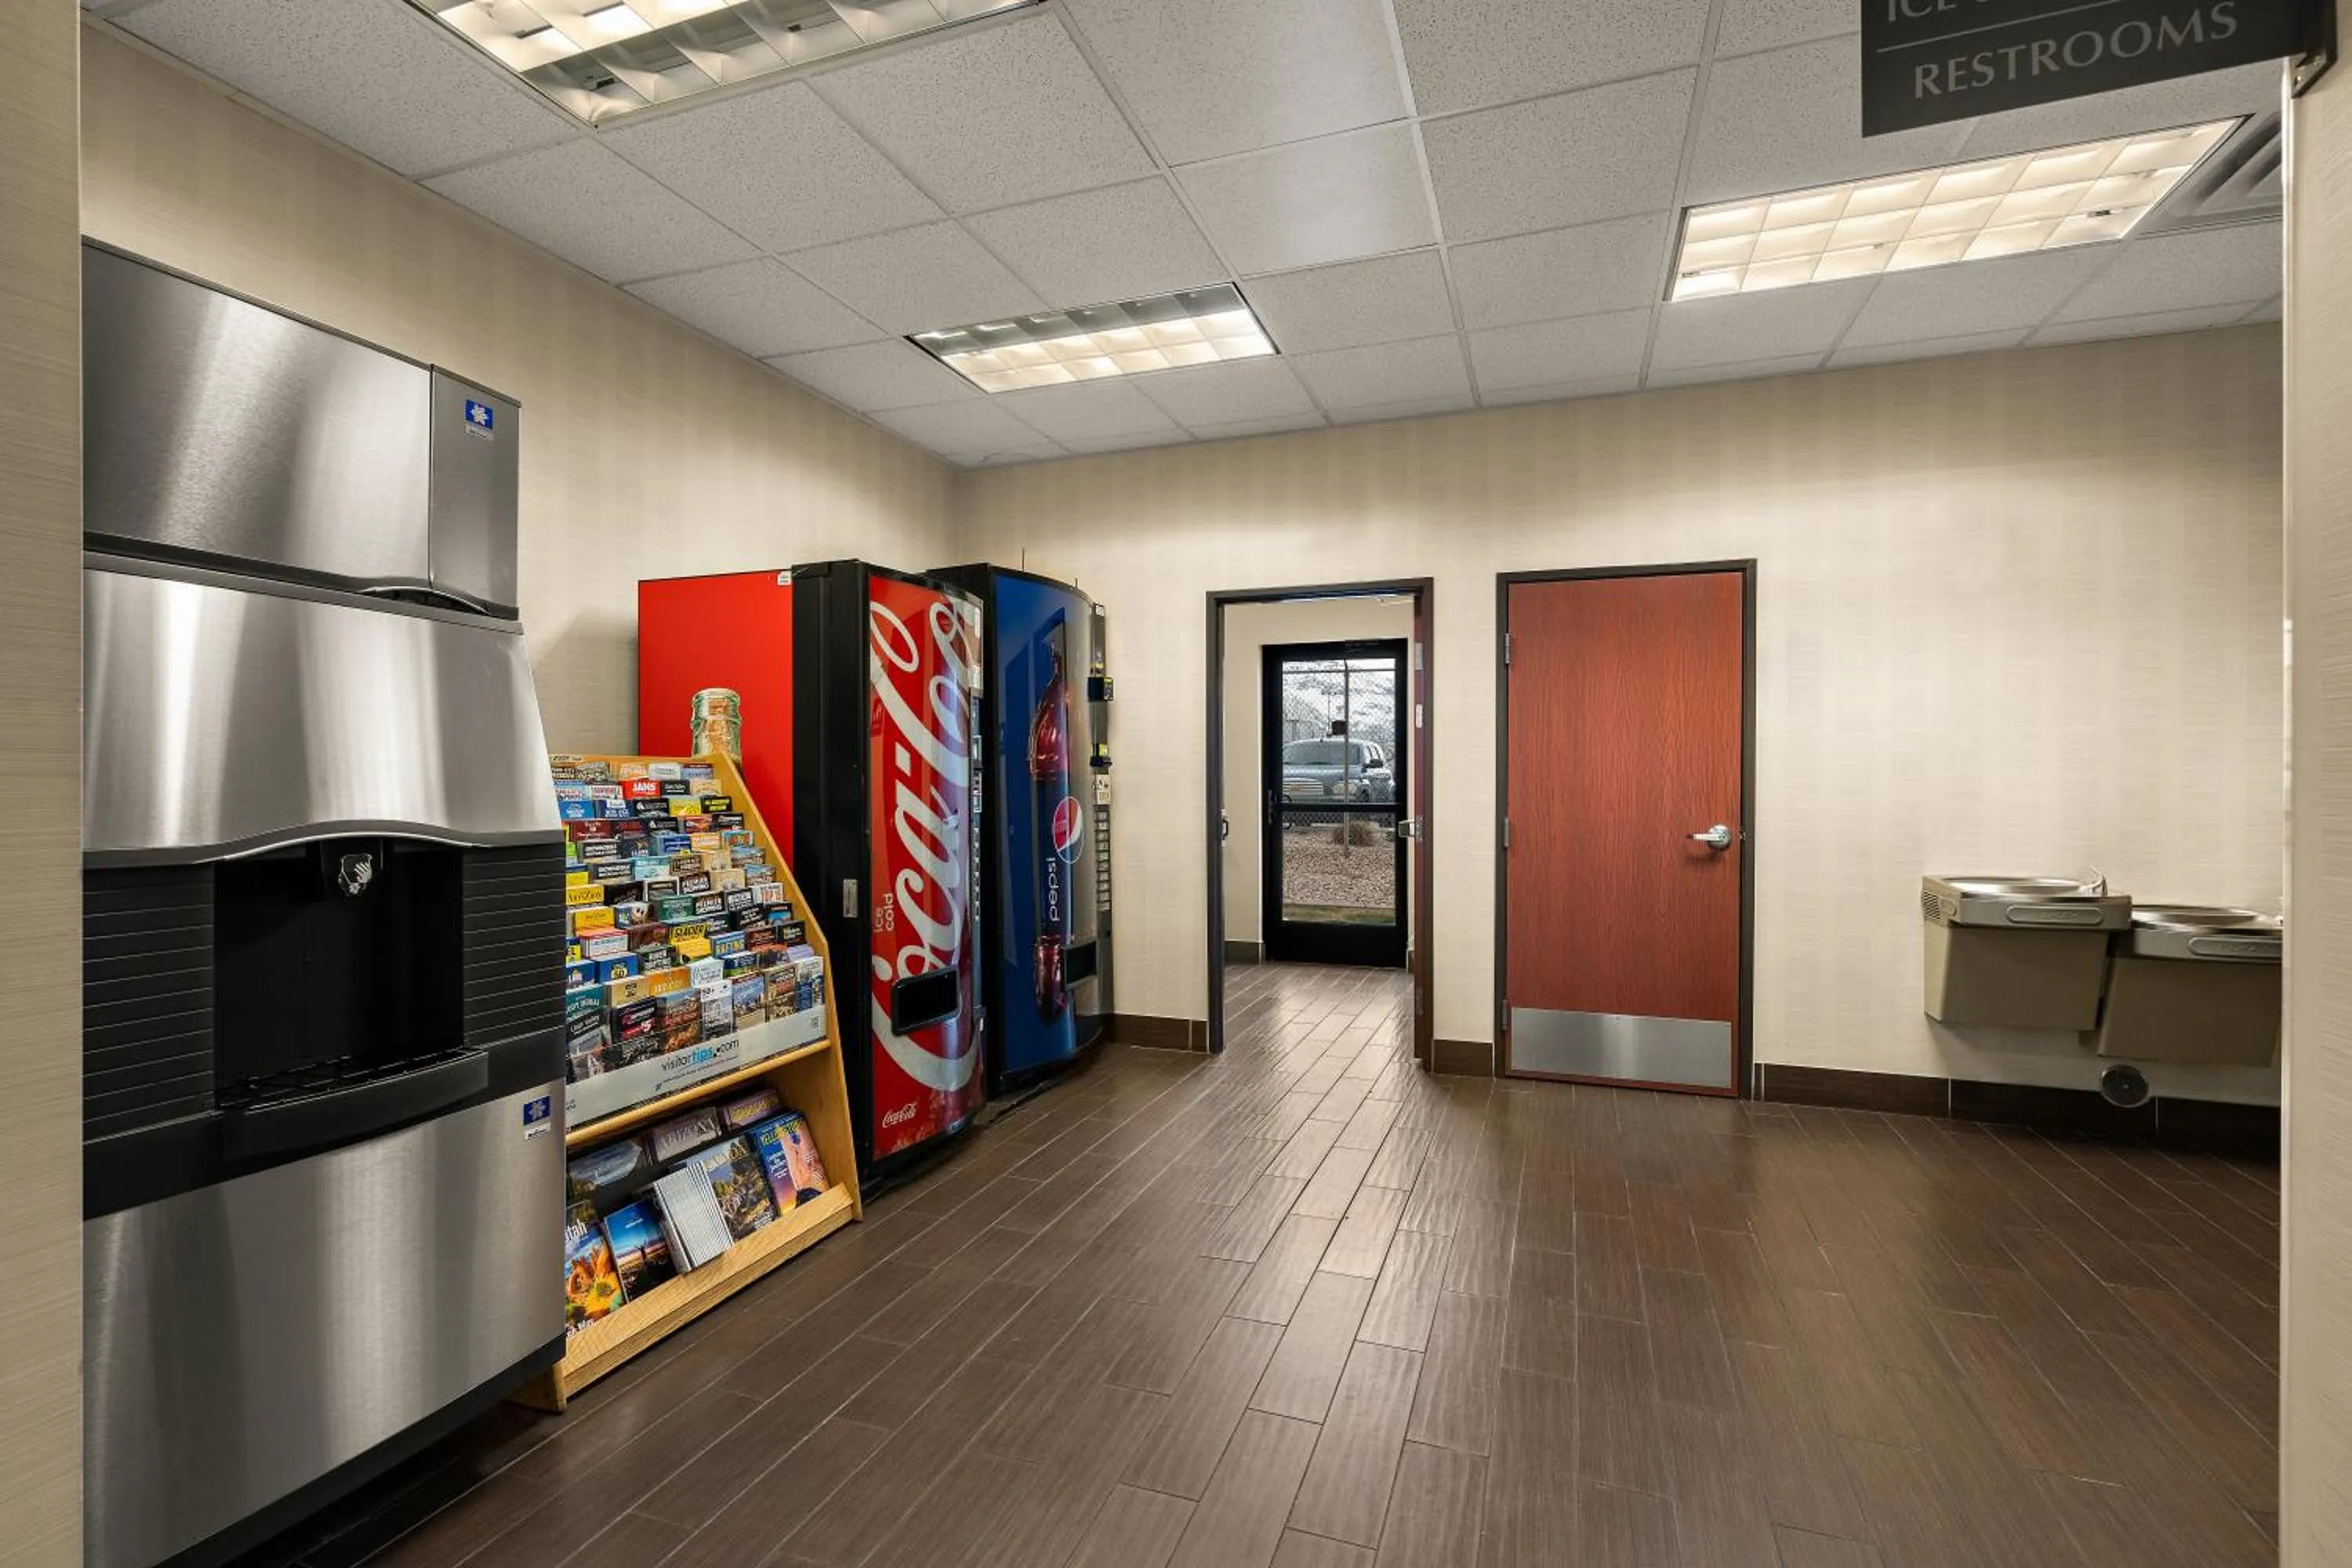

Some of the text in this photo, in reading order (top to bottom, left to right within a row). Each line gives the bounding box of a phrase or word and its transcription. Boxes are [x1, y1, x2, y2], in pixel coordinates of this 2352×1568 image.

[1914, 1, 2238, 100] RESTROOMS
[1046, 857, 1060, 921] pepsi
[873, 907, 884, 932] ice
[883, 892, 894, 931] cold
[662, 1039, 739, 1073] visitortips.com
[882, 1102, 918, 1127] Coca-Cola
